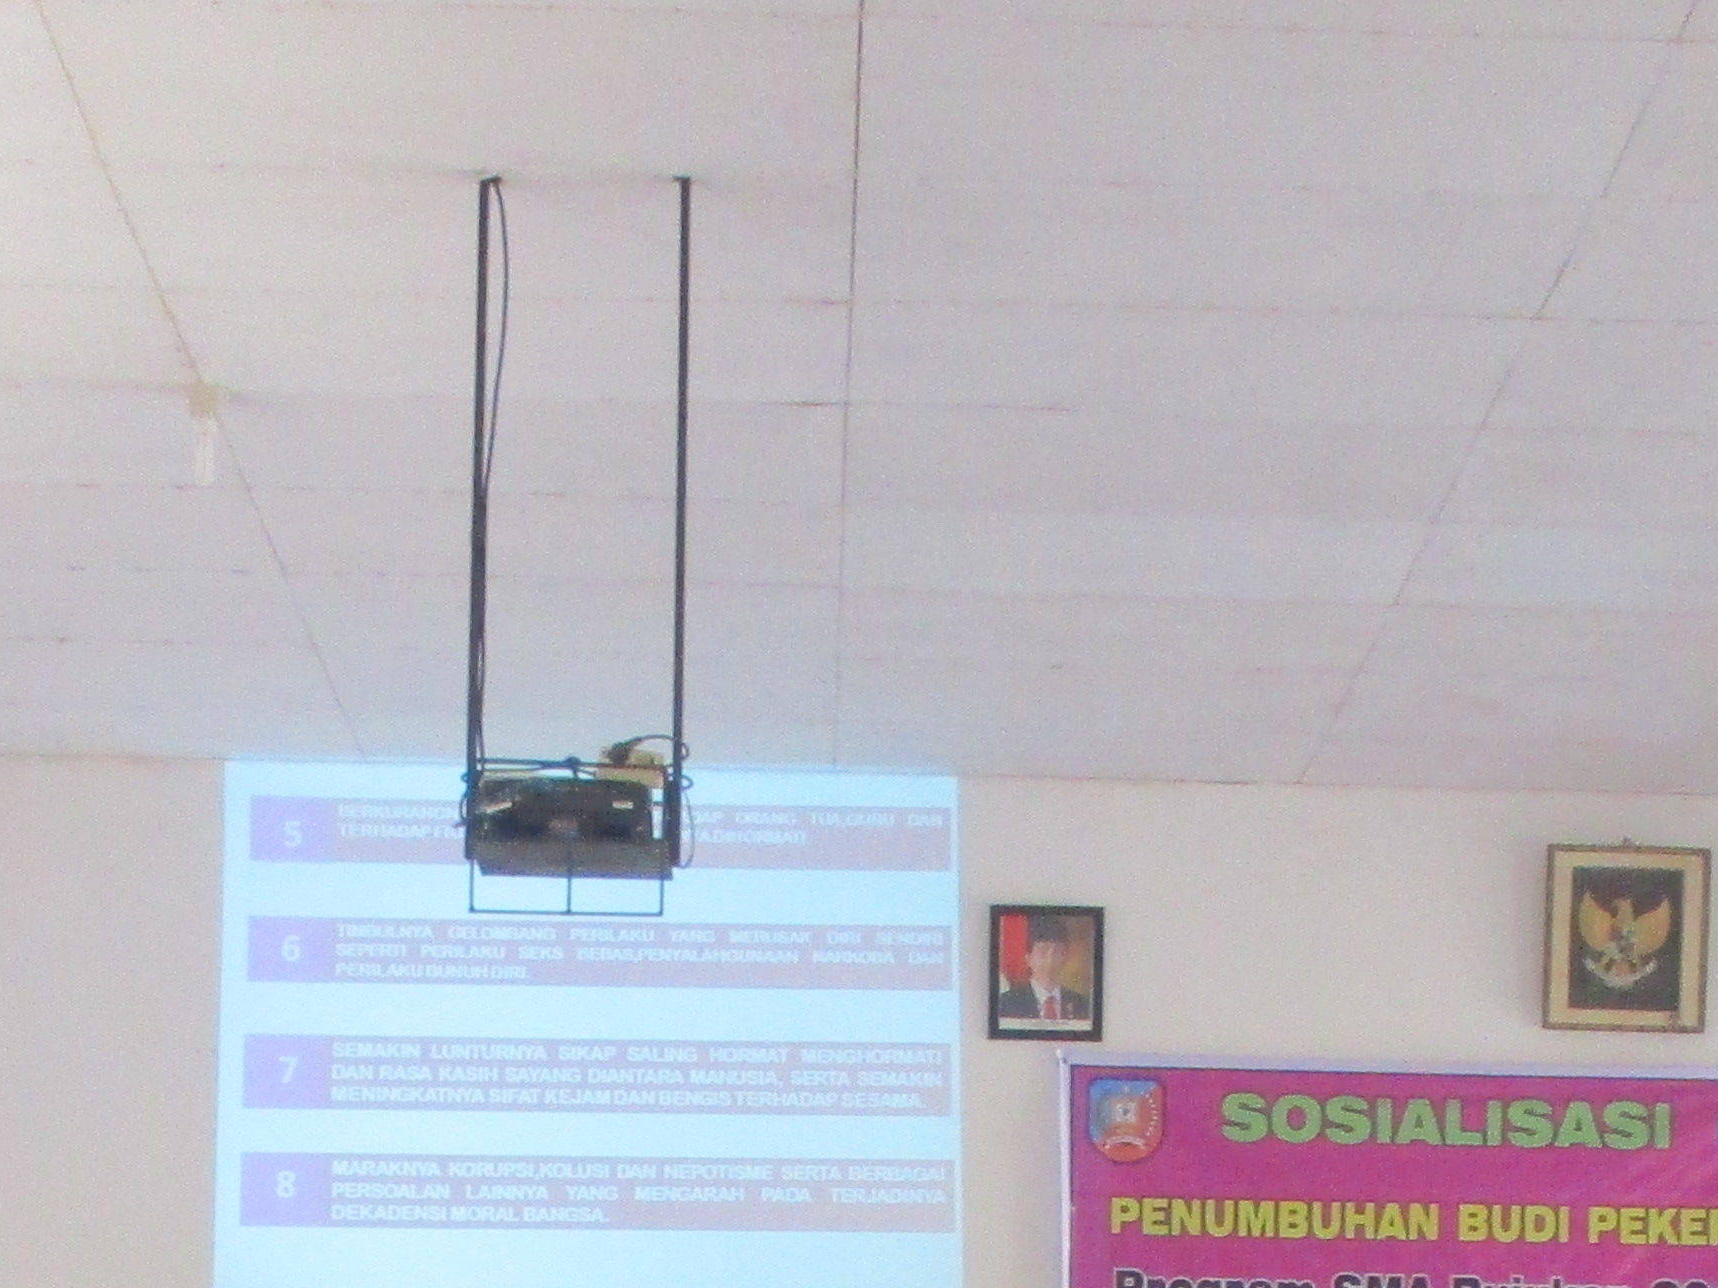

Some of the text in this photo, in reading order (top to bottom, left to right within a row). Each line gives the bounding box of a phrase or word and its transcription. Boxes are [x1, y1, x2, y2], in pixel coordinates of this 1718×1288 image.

[283, 820, 303, 848] 5
[282, 935, 303, 962] 6
[333, 1043, 421, 1058] SEMAKIN
[430, 1043, 548, 1061] LUNTURNYA
[626, 1047, 698, 1062] SALING
[279, 1056, 299, 1083] 7
[333, 1065, 374, 1080] DAN
[380, 1065, 433, 1081] RASA
[439, 1066, 498, 1082] KASIH
[505, 1067, 581, 1083] SAYANG
[1220, 1092, 1673, 1149] SOSIALISASI
[333, 1161, 440, 1177] MARAKNYA
[617, 1164, 656, 1179] DAN
[276, 1170, 296, 1198] 8
[332, 1183, 451, 1199] PERSOALAN
[465, 1185, 549, 1200] LAINNYA
[332, 1205, 447, 1220] DEKADENSI
[449, 1206, 518, 1221] MORAL
[1110, 1196, 1440, 1241] PENUMBUHAN
[1459, 1204, 1569, 1243] BUDI
